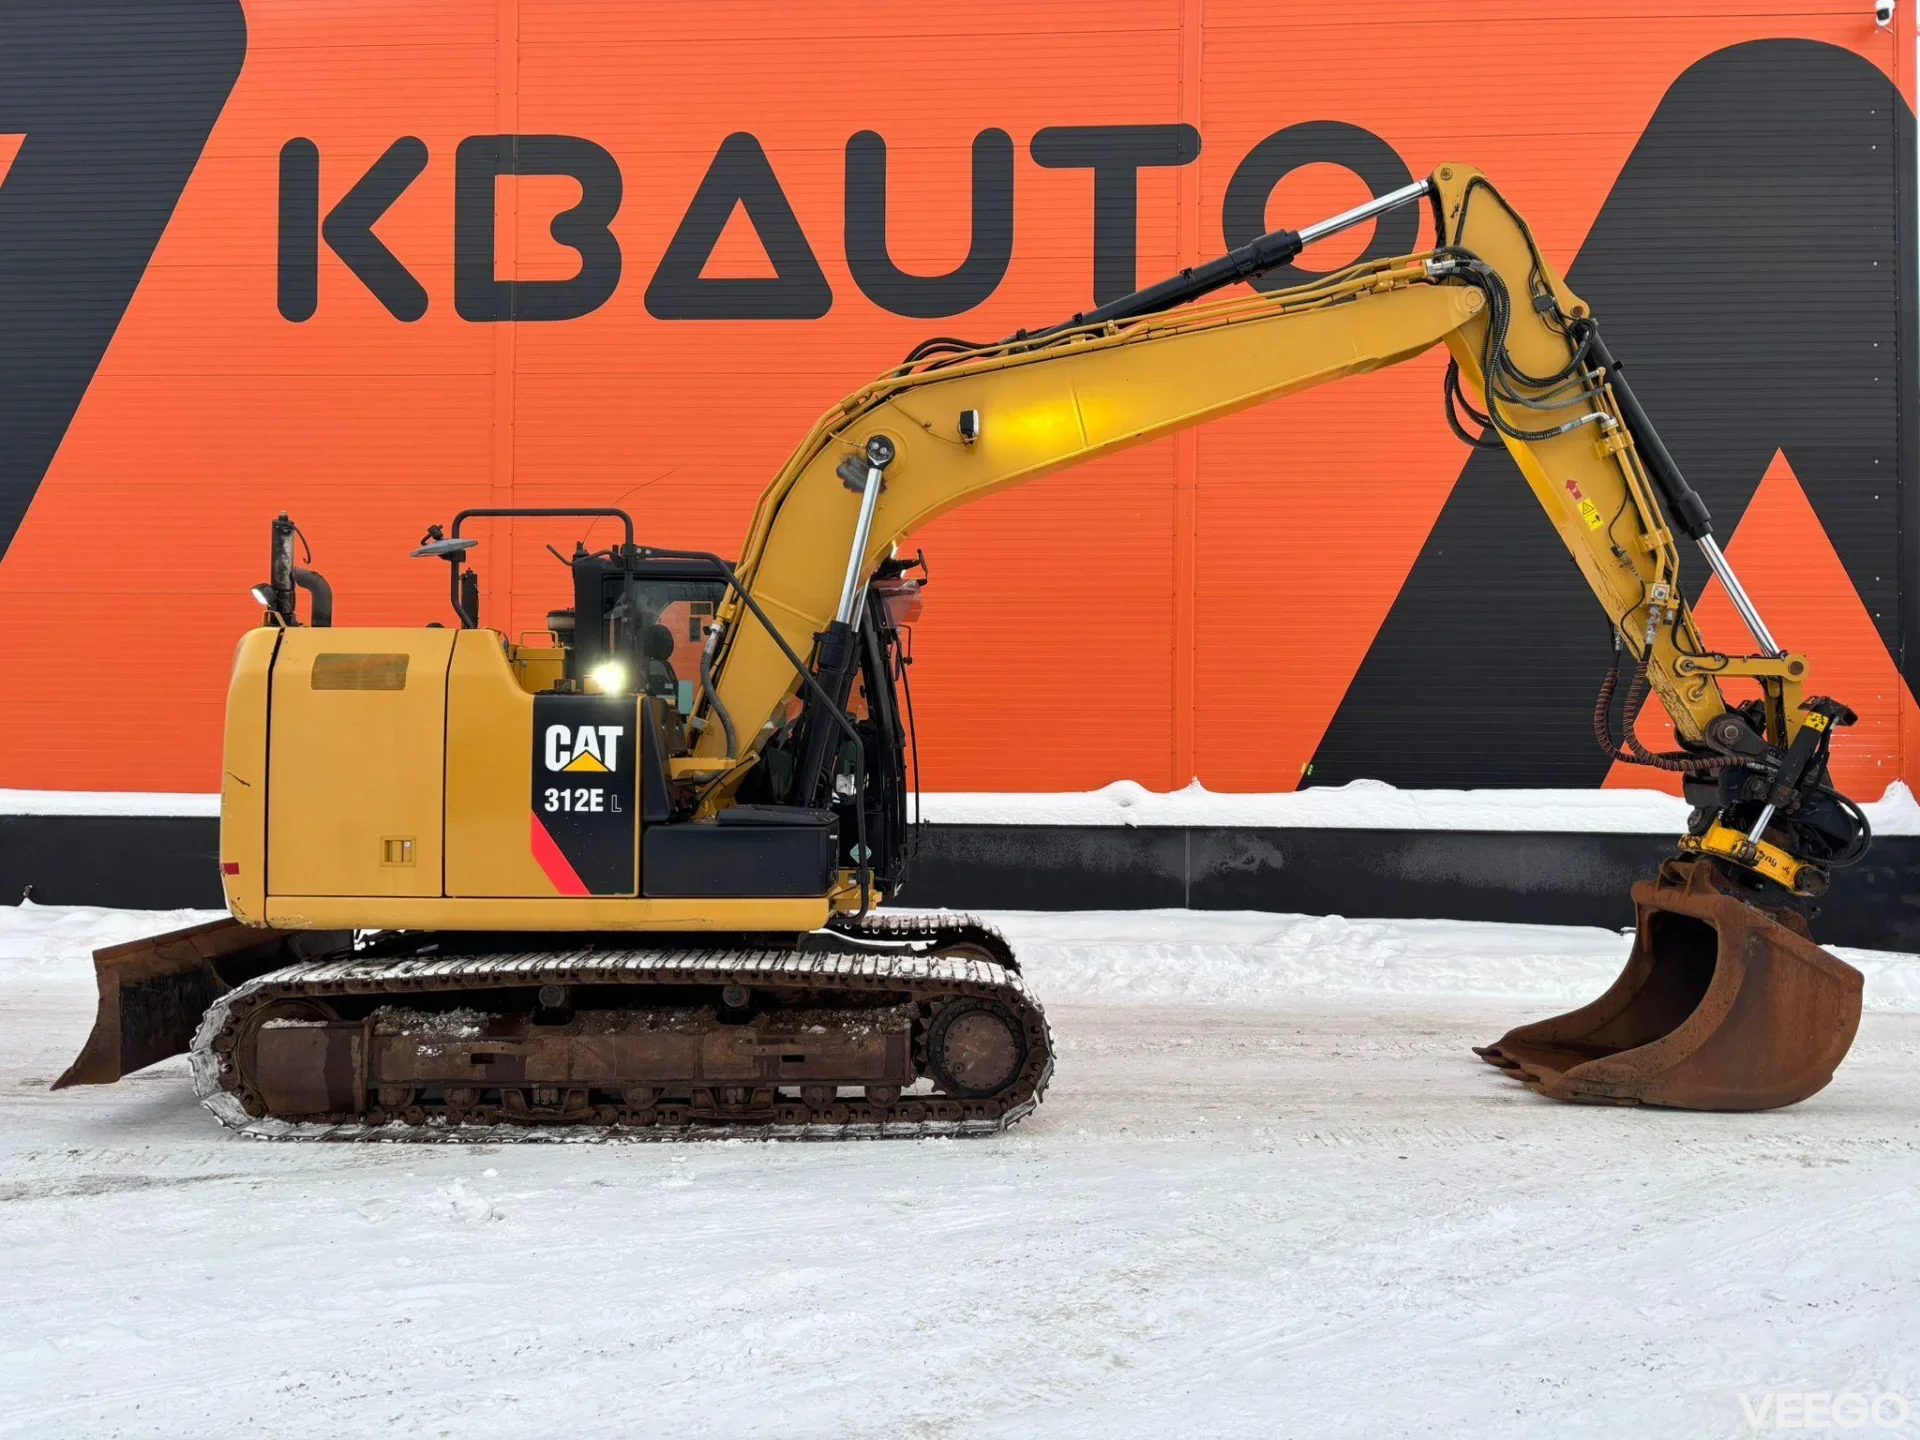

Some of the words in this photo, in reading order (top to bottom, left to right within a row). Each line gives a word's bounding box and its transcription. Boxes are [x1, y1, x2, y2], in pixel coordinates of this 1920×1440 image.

[277, 120, 1420, 323] KBAUTO
[544, 724, 624, 772] CAT
[544, 788, 604, 812] 312E
[611, 794, 622, 812] L
